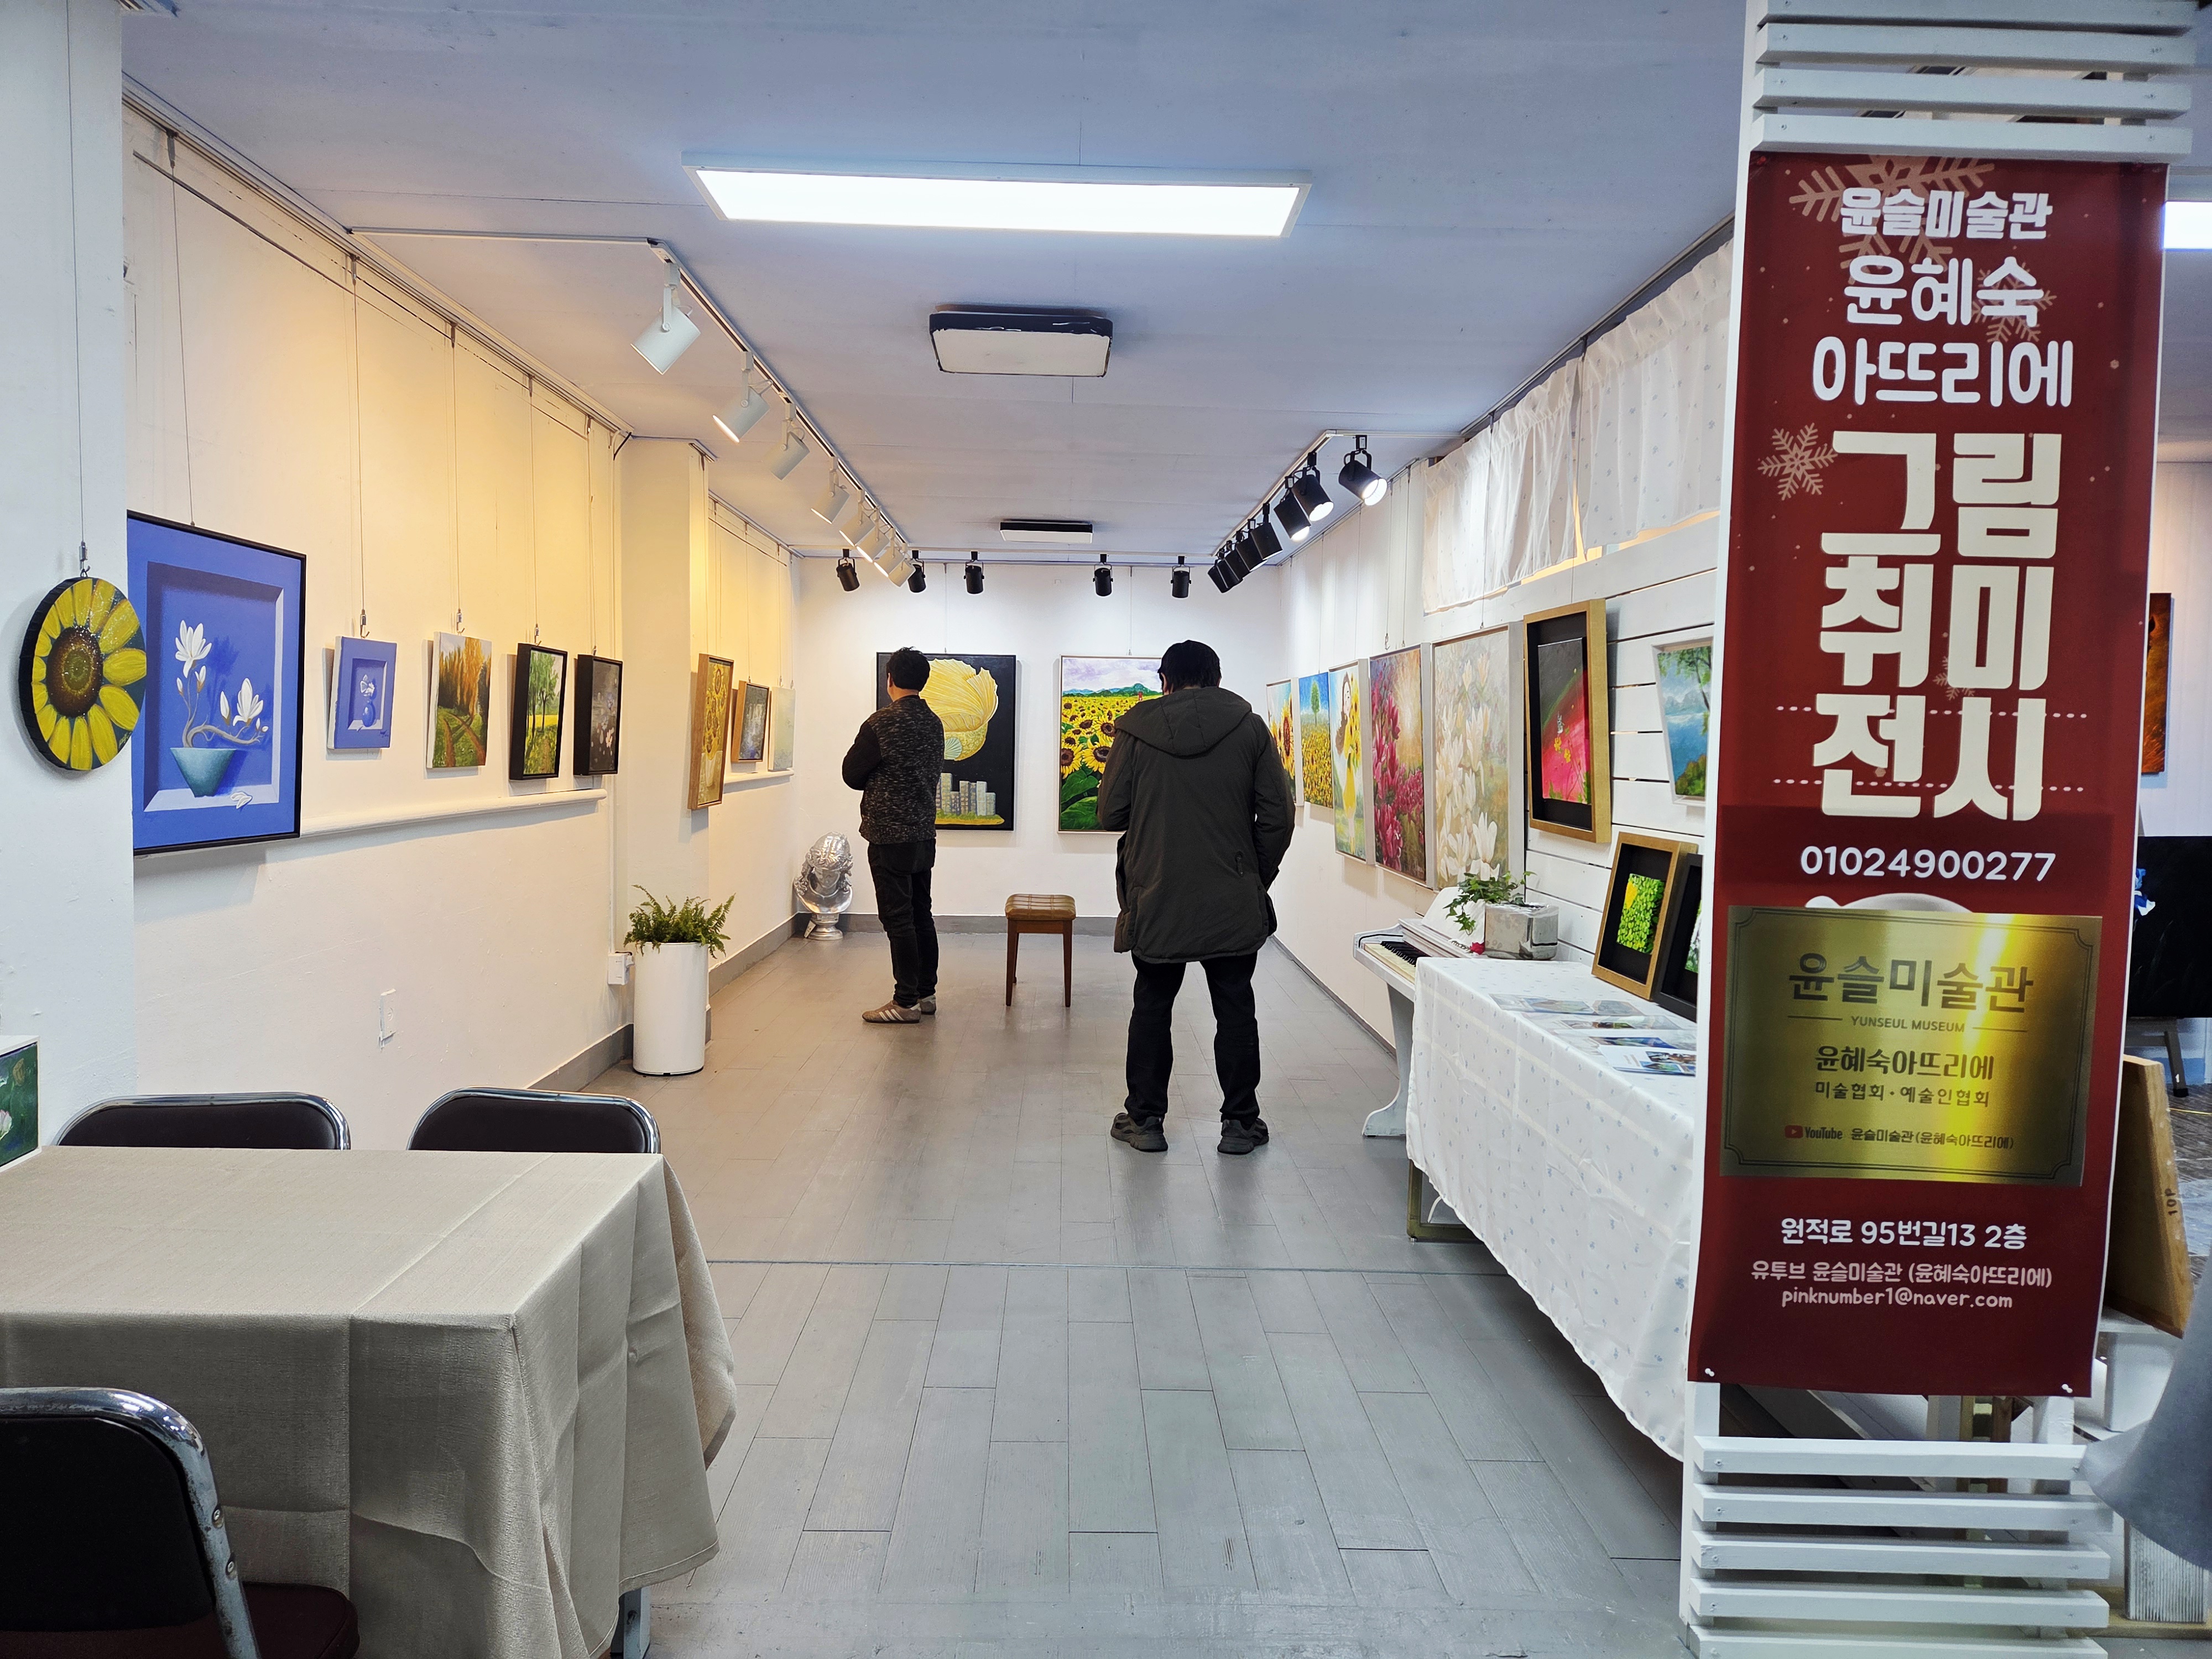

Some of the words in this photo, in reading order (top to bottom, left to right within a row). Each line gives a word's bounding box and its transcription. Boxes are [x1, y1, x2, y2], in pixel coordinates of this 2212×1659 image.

[1840, 187, 2053, 239] 윤슬미술관
[1844, 255, 2044, 327] 윤혜숙
[1813, 336, 2073, 407] 아뜨리에
[1820, 431, 2062, 559] 그림
[1819, 556, 2054, 690] 취미
[1813, 693, 2047, 821] 전시
[1801, 846, 2056, 881] 01024900277
[1789, 953, 2033, 1014] 윤슬미술관
[1851, 1016, 1908, 1029] YUNSEUL
[1911, 1020, 1965, 1032] MUSEUM
[1815, 1045, 1994, 1080] 윤혜숙아뜨리에
[1805, 1126, 1843, 1140] YouTube
[1781, 1218, 1853, 1244] 원적로
[1861, 1220, 1975, 1246] 95번길13
[1984, 1223, 2027, 1249] 2층
[1751, 1260, 1806, 1280] 유투브
[1812, 1261, 1903, 1282] 윤슬미술관
[1908, 1262, 2052, 1288] (윤혜숙아뜨리에)
[1782, 1286, 2013, 1308] pinknumber1@naver.com
